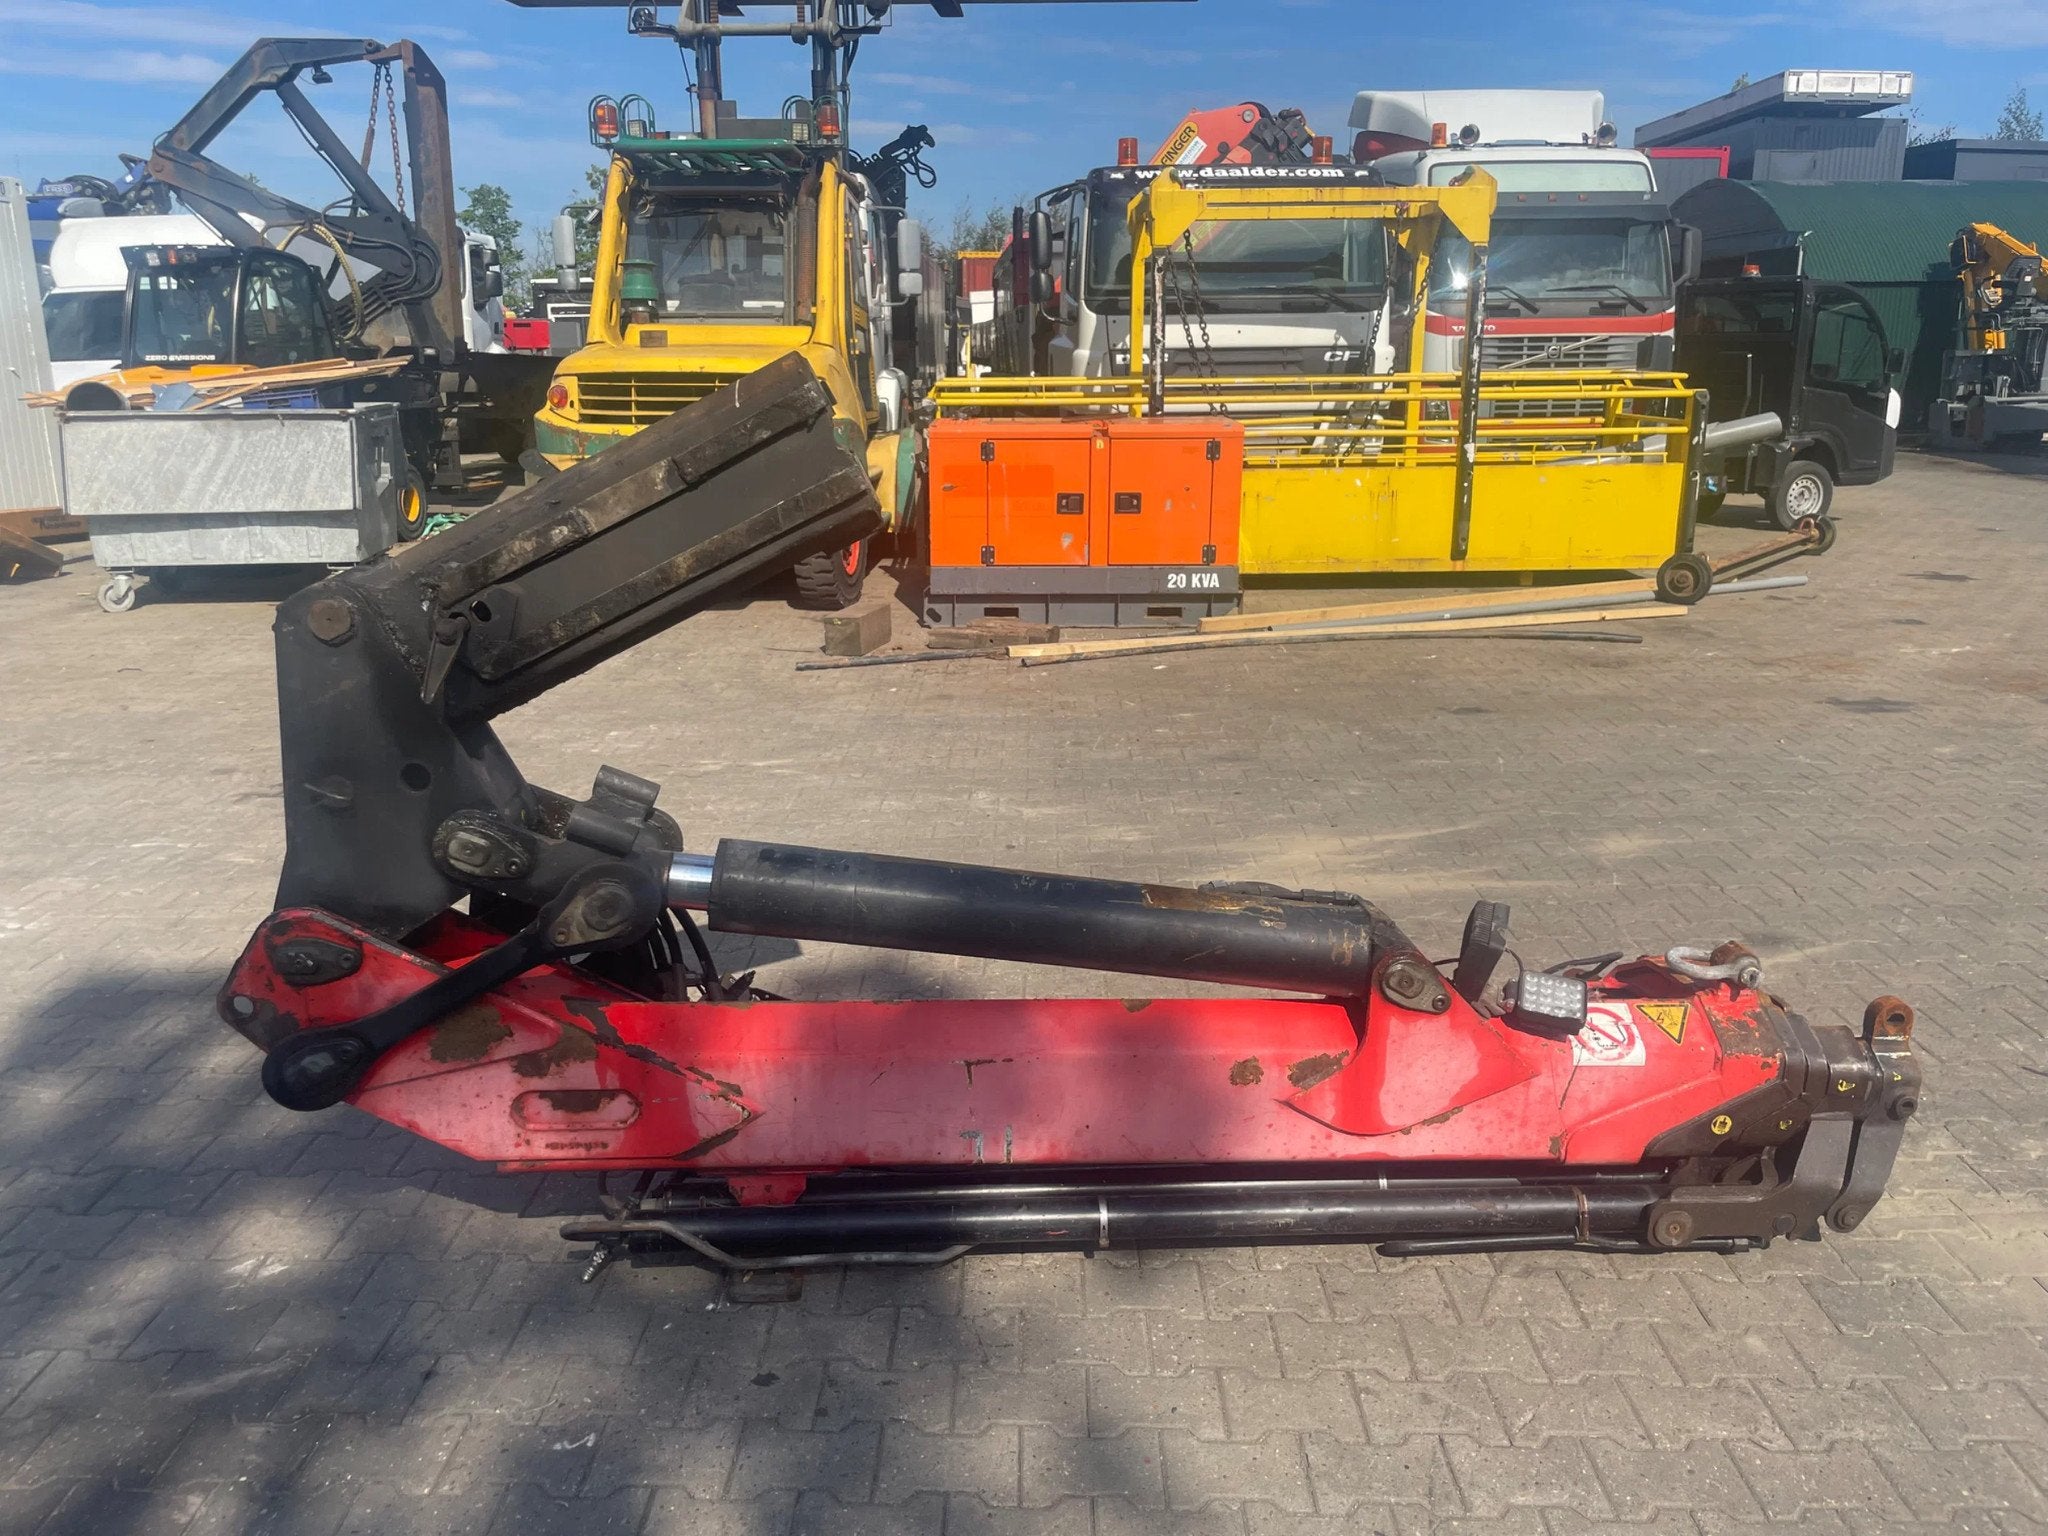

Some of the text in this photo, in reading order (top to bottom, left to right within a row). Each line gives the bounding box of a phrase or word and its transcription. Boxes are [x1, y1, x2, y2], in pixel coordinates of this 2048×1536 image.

[1323, 350, 1361, 361] CF
[1167, 573, 1220, 588] 20 KVA
